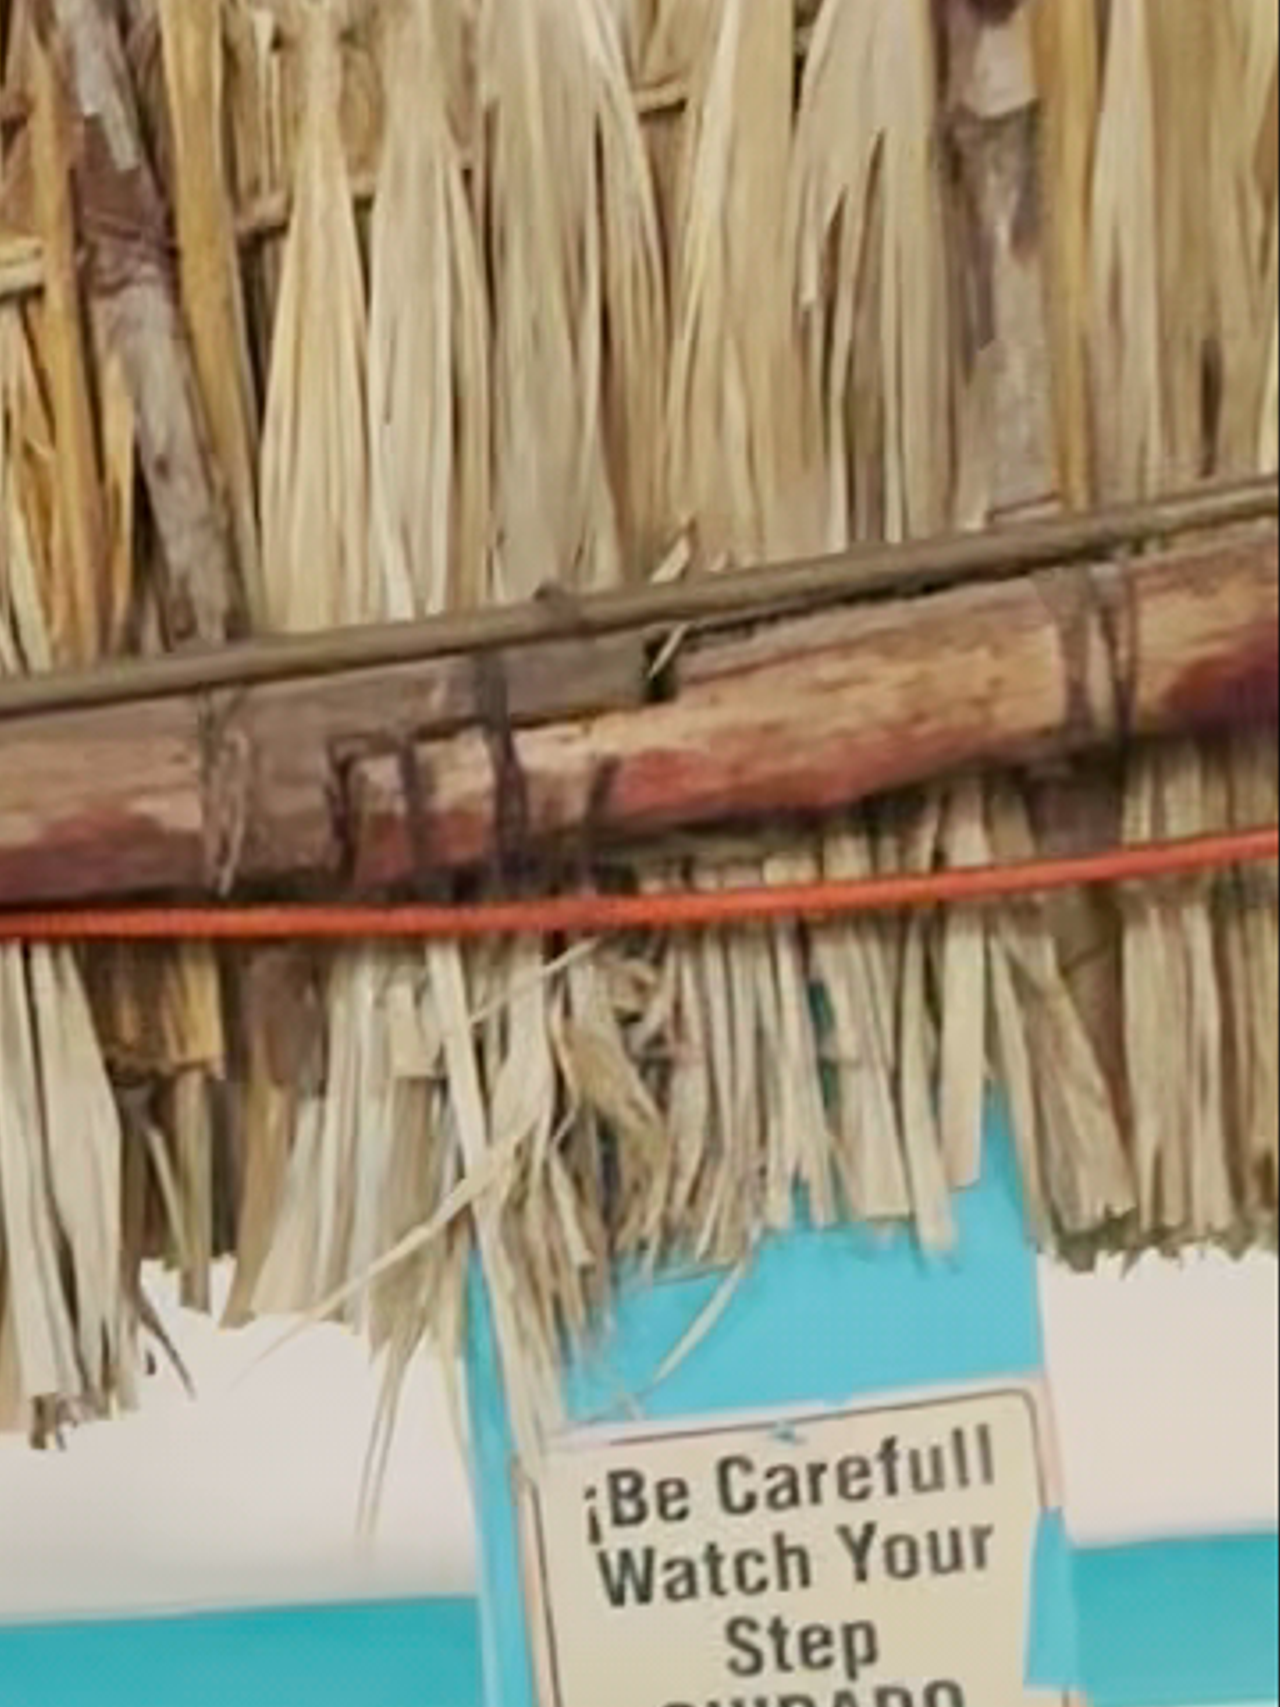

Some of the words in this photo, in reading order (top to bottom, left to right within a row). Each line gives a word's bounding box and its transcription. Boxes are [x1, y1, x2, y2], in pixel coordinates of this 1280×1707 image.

[583, 1467, 691, 1547] ¡Be
[597, 1530, 813, 1609] Watch
[835, 1520, 995, 1584] Your
[723, 1614, 880, 1684] Step
